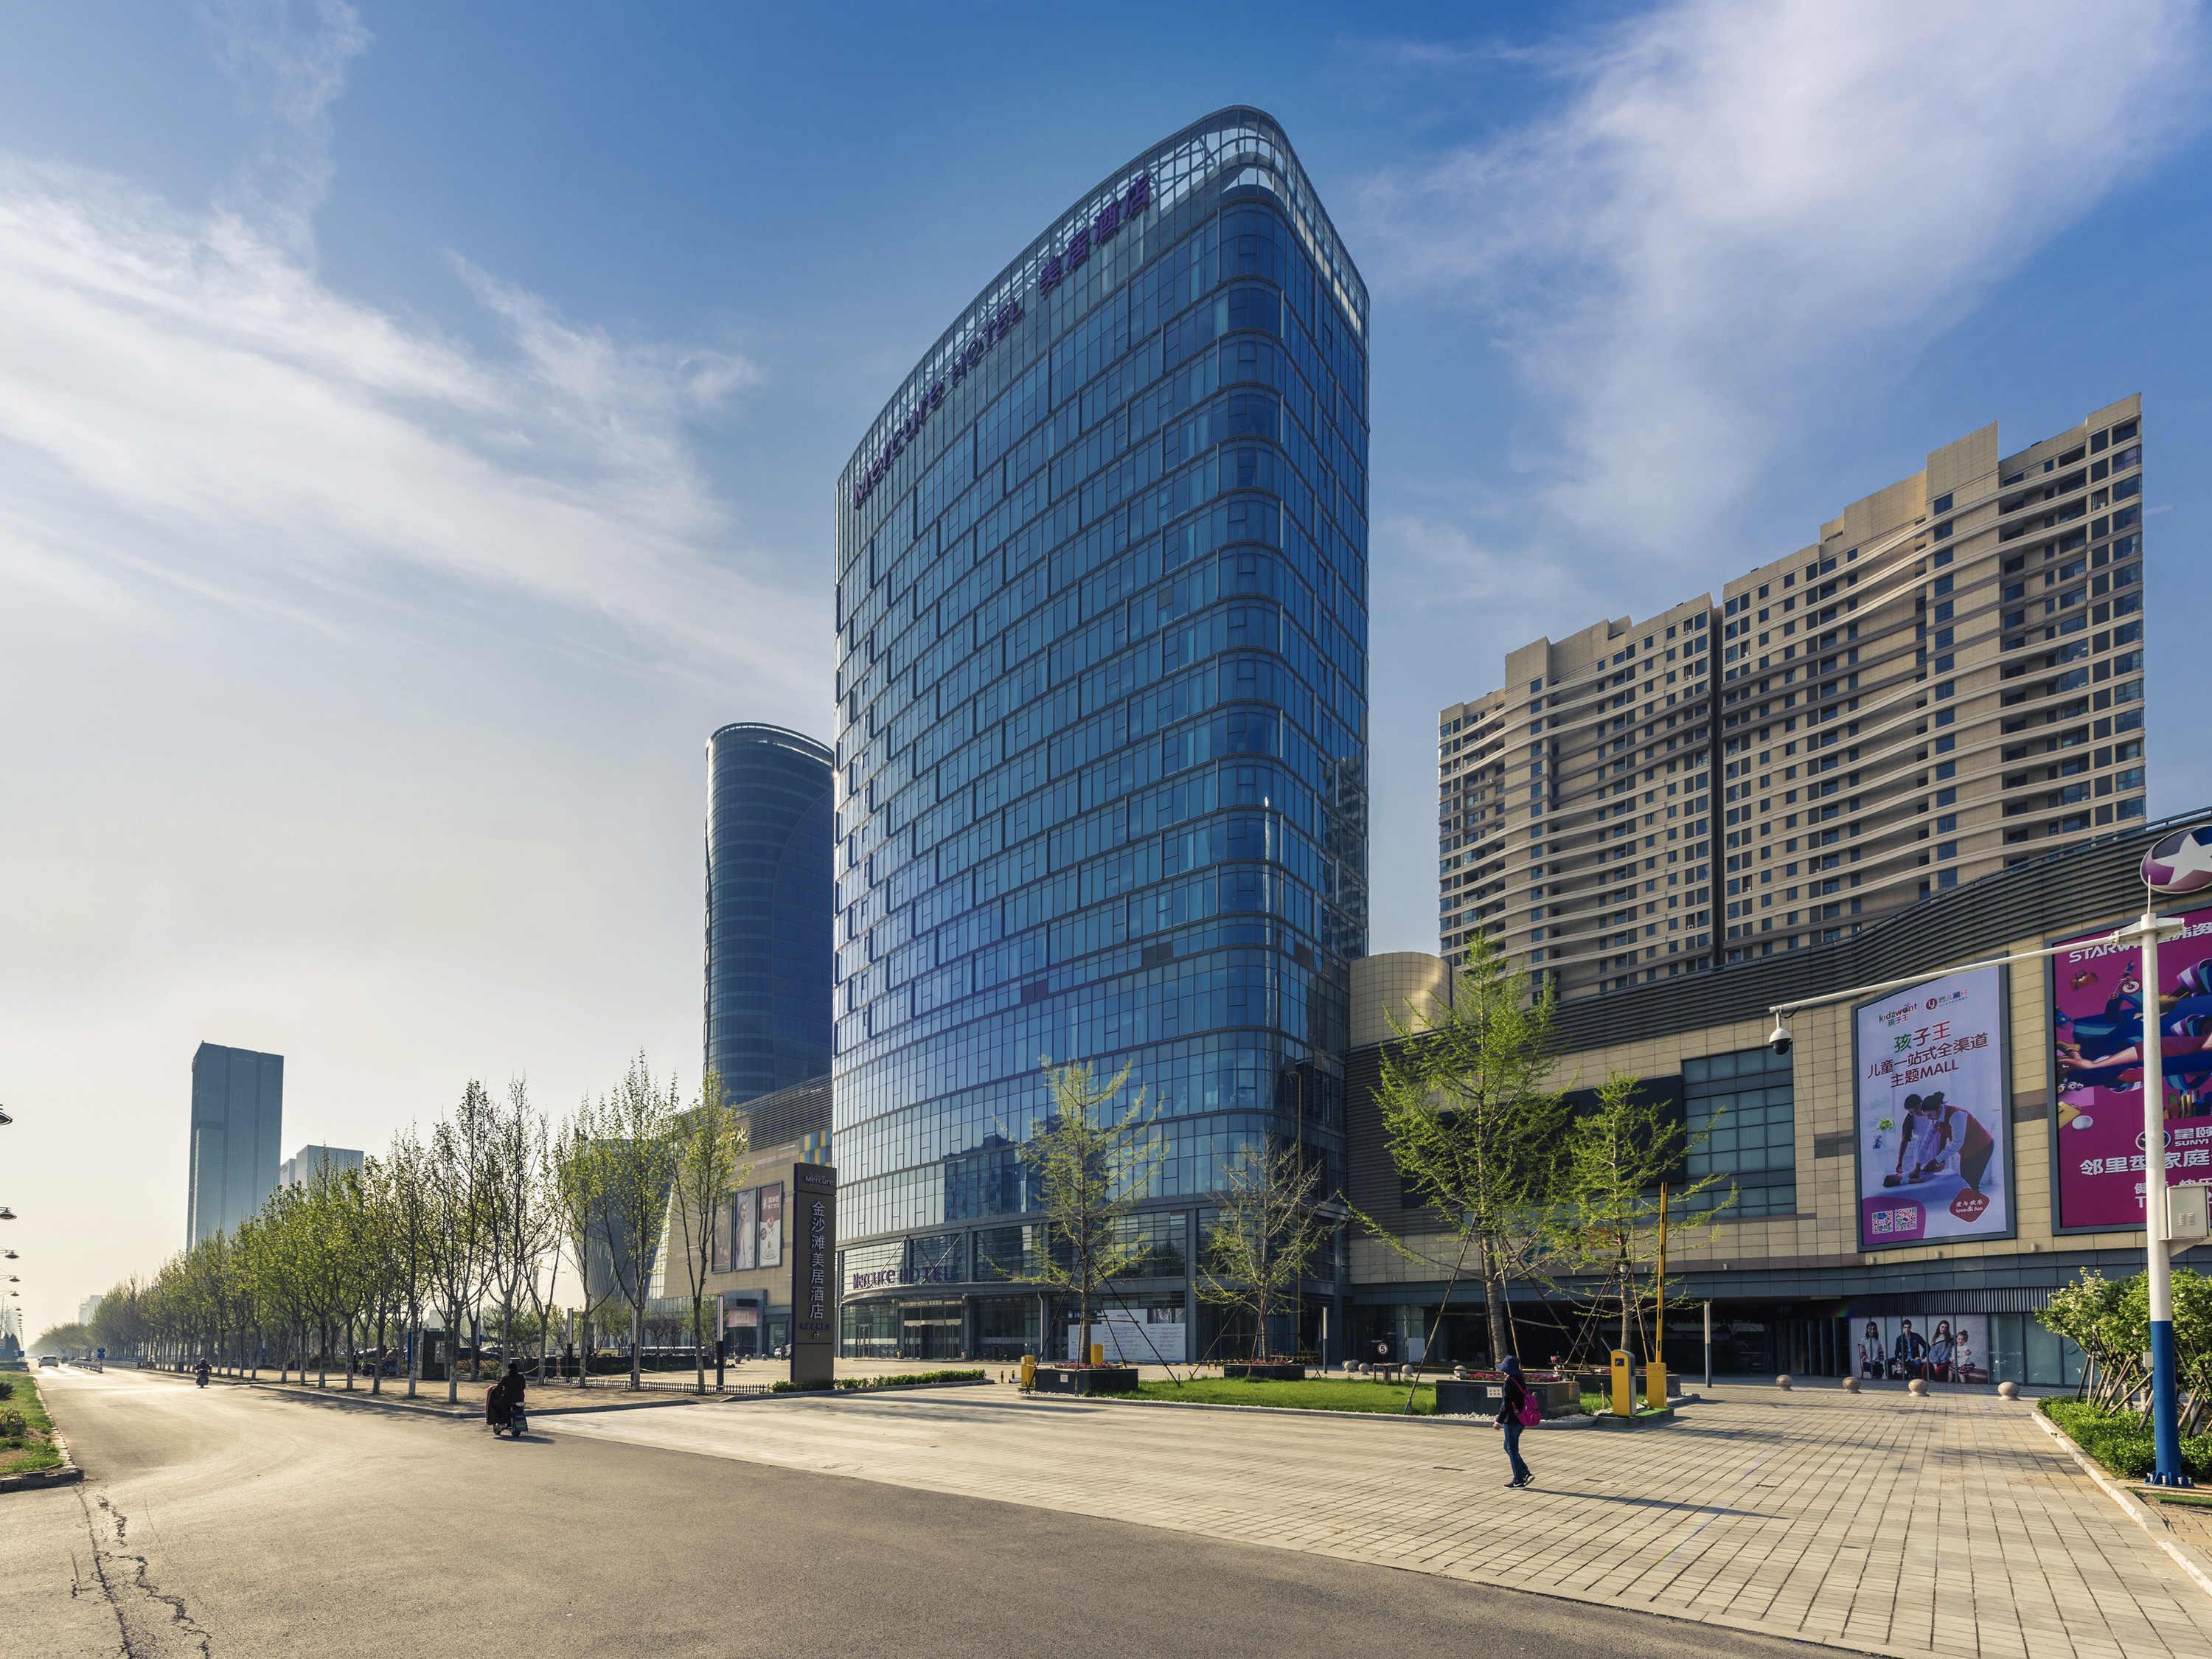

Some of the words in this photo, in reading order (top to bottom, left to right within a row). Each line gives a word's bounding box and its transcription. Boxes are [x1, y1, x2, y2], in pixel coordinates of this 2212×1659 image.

[1040, 174, 1151, 299] 美居酒店
[854, 380, 944, 510] Mercure
[950, 296, 1025, 388] HOTEL
[1887, 1013, 1910, 1027] 孩子王
[1893, 1020, 1952, 1054] 孩子王
[1867, 1032, 1989, 1079] 儿童一站式全渠道
[1891, 1059, 1959, 1088] 主题MALL
[2079, 1149, 2212, 1176] 邻里型家庭
[810, 1200, 826, 1320] 金沙滩美居酒店
[852, 1269, 896, 1290] Mercure
[899, 1266, 952, 1284] HOTEL
